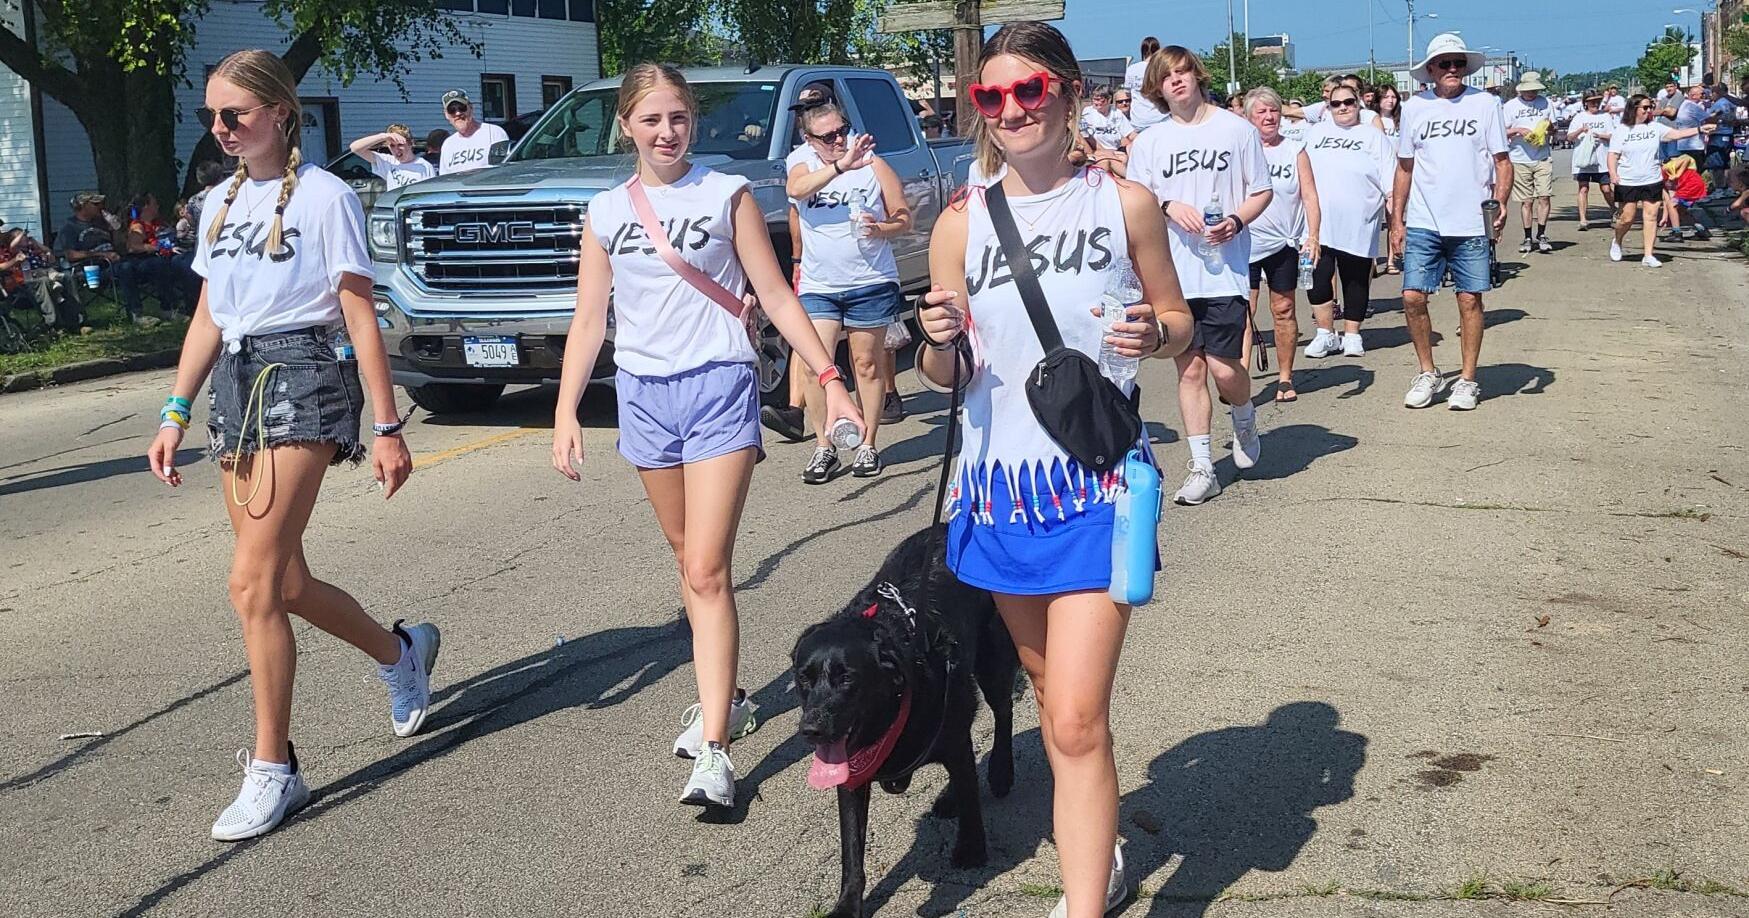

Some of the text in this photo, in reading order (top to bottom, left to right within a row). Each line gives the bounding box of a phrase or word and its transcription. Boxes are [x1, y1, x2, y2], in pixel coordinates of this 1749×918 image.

[1515, 108, 1544, 119] JESUS
[1420, 119, 1477, 140] JESUS
[1624, 130, 1656, 142] JESUS
[1314, 136, 1363, 151] JESUS
[448, 148, 484, 167] JESUS
[1162, 149, 1231, 178] JESUS
[210, 220, 302, 263] ESUS
[455, 221, 534, 243] GMC
[966, 227, 1112, 296] JESUS
[481, 344, 507, 360] 5049
